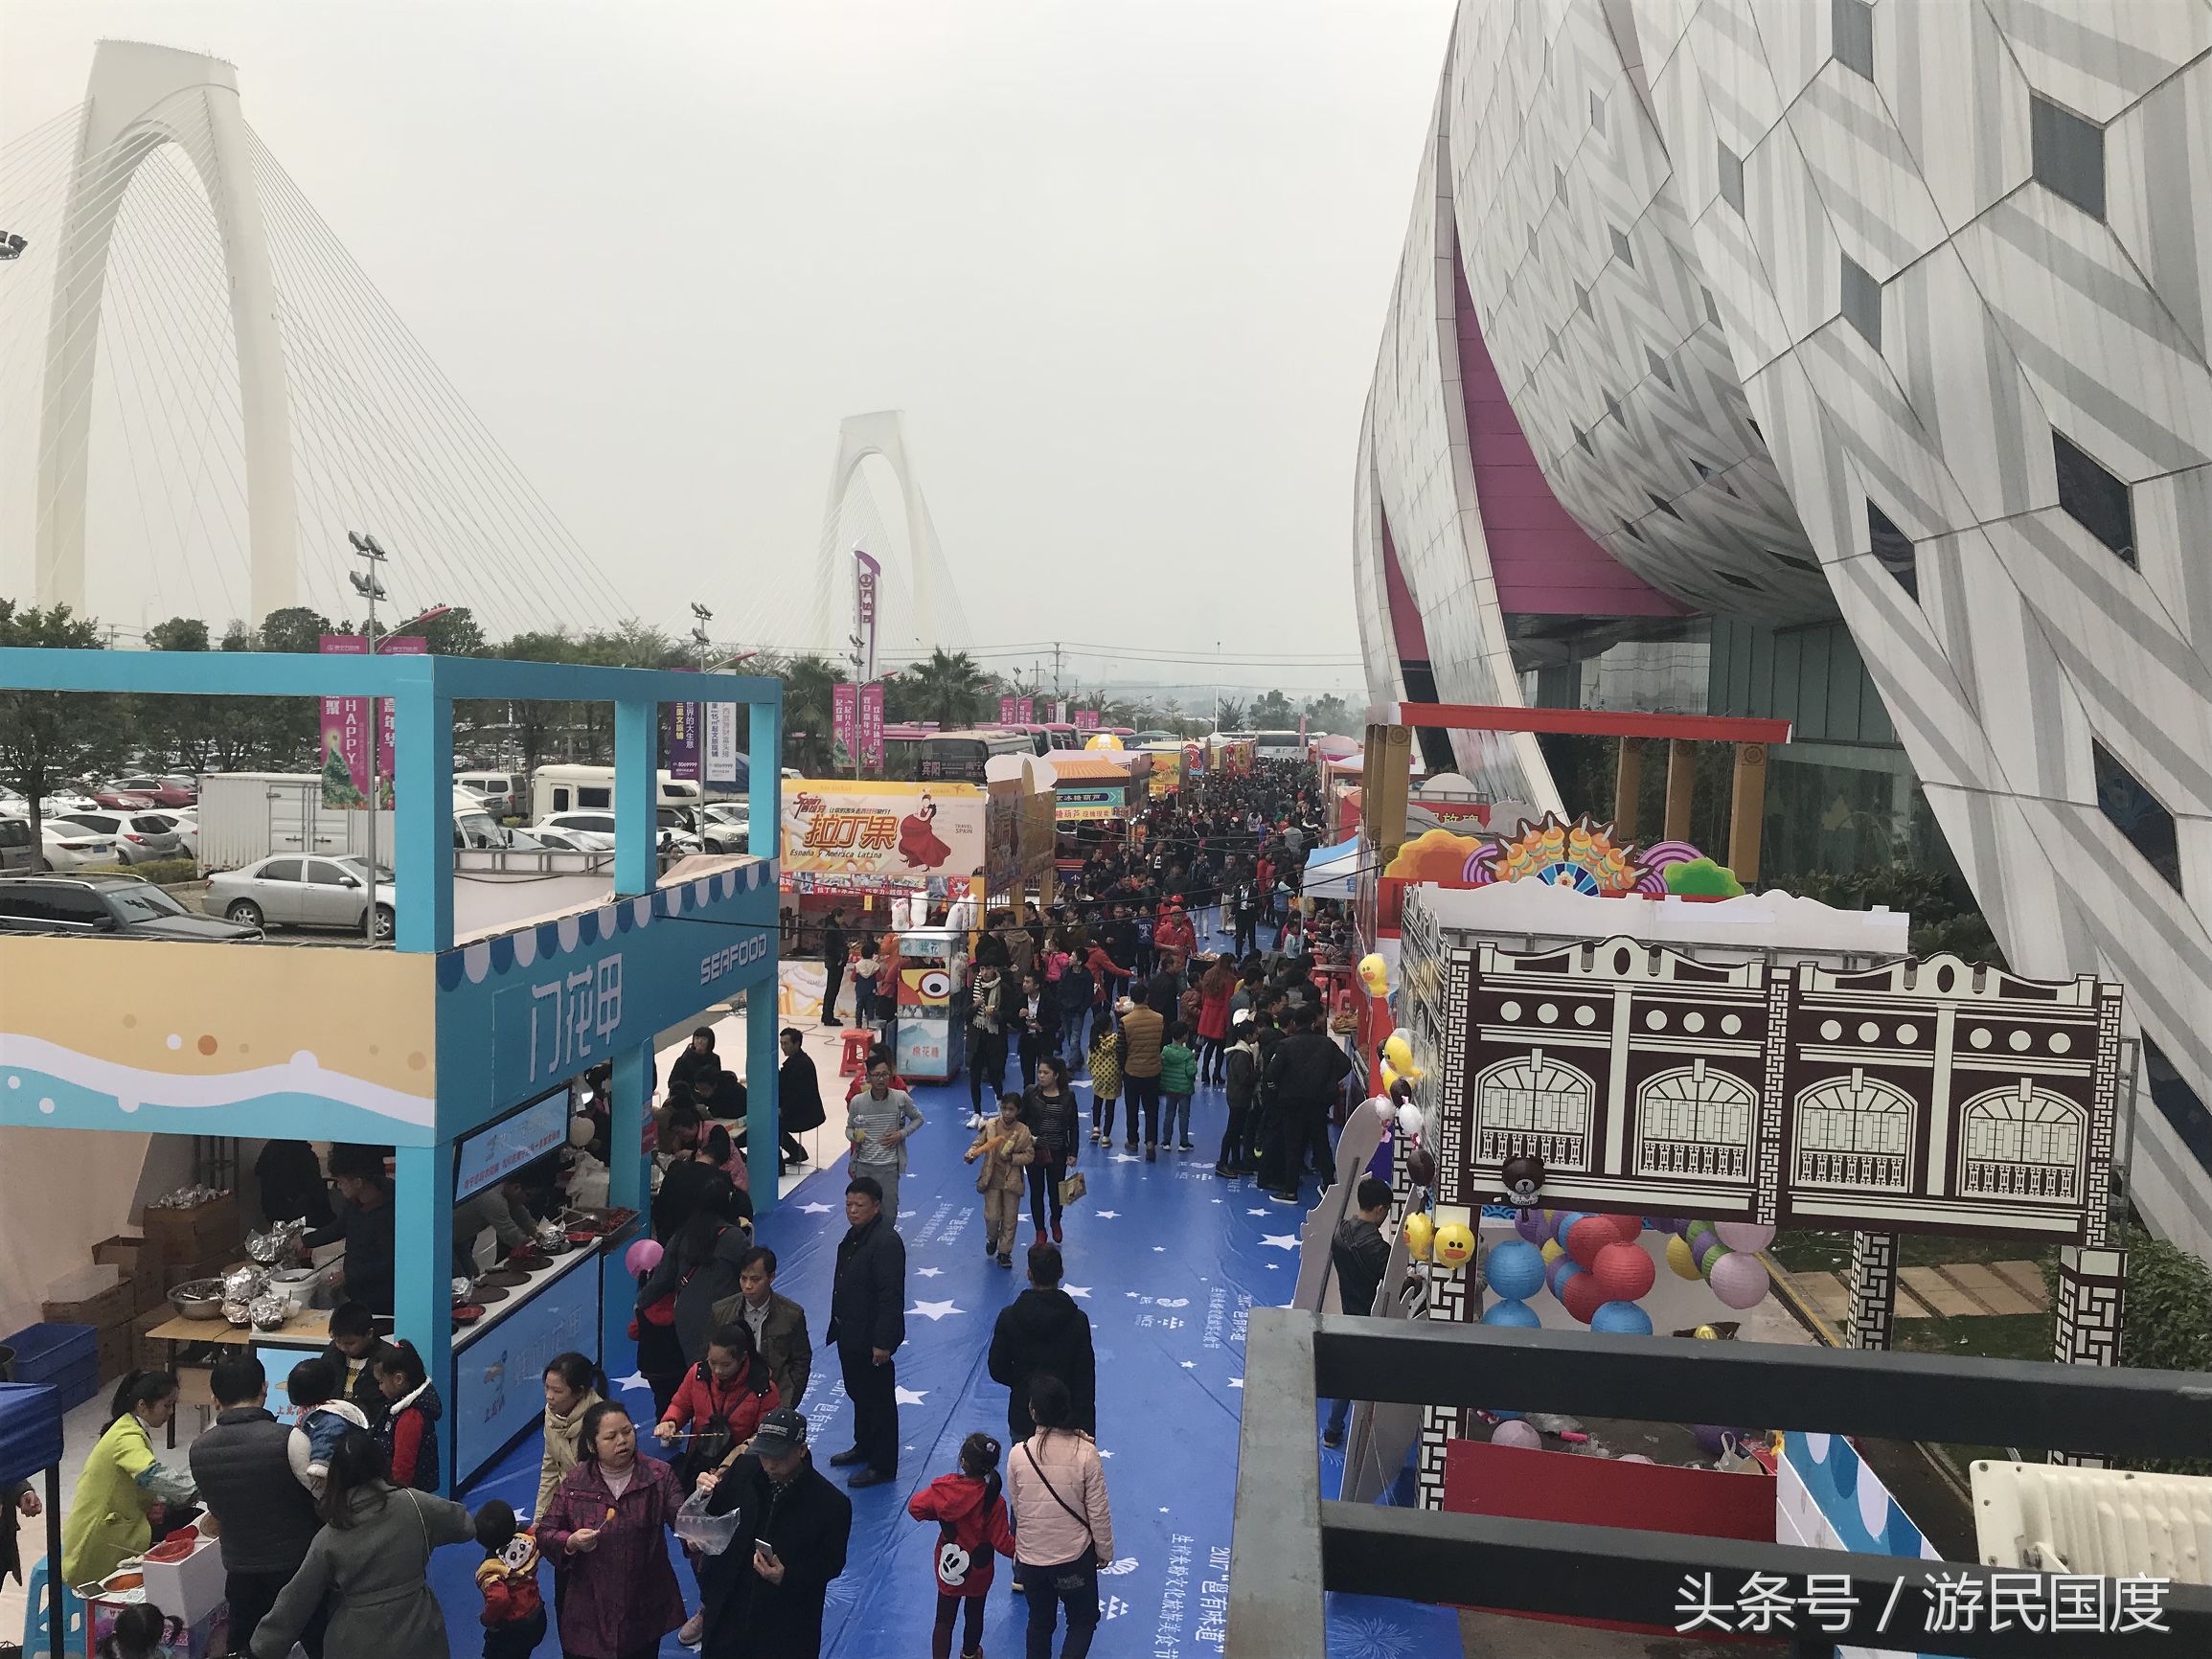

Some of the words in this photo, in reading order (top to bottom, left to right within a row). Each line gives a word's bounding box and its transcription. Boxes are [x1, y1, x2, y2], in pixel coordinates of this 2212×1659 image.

[346, 699, 356, 764] HAPPY
[789, 849, 814, 857] España
[857, 851, 882, 859] Latina
[803, 814, 900, 851] 拉丁果
[700, 933, 767, 986] SEAFOOD
[529, 952, 623, 1082] 门花甲
